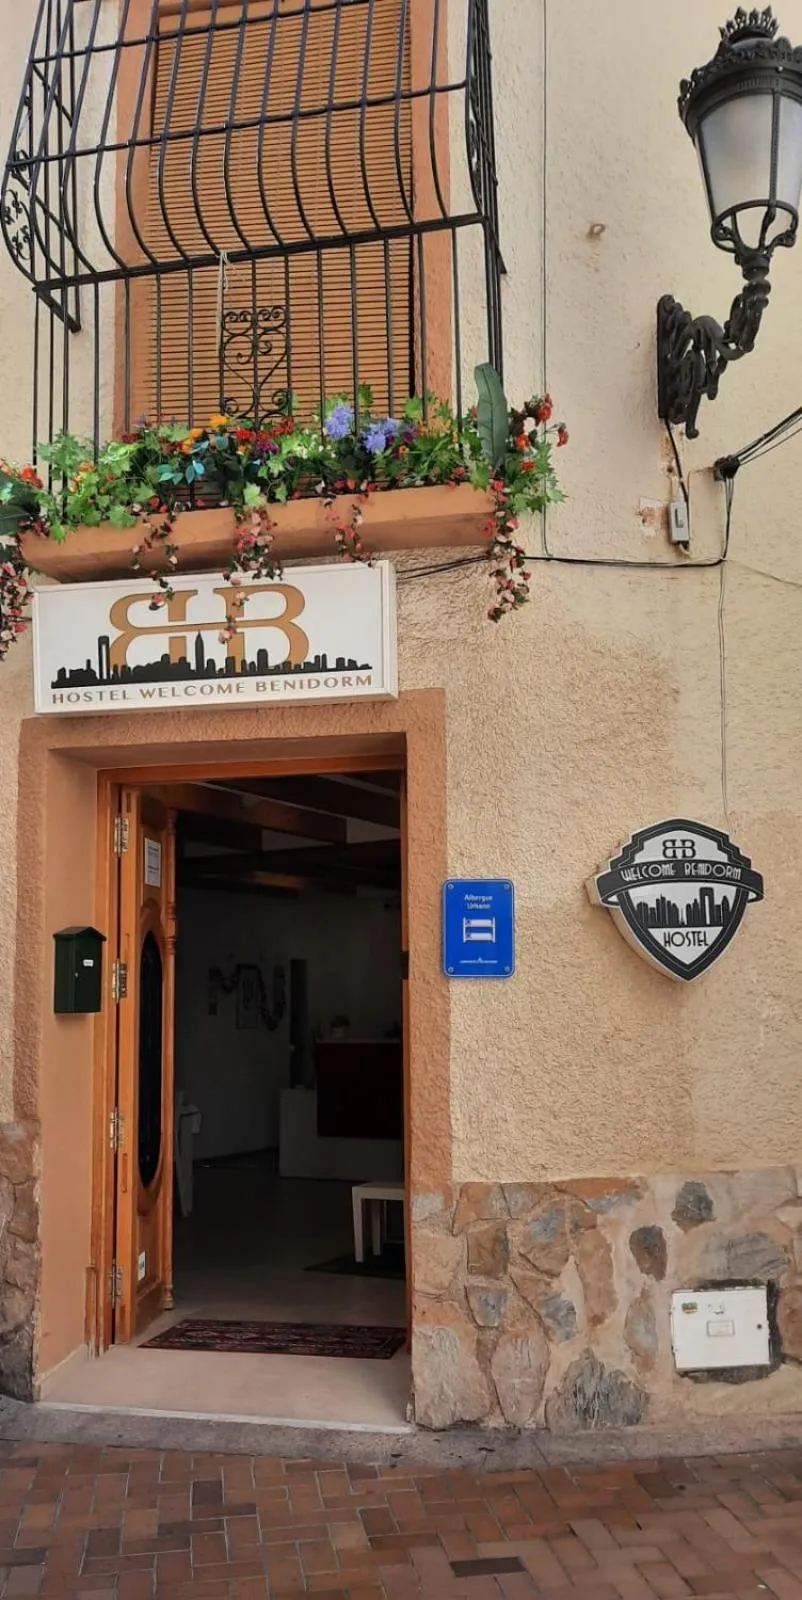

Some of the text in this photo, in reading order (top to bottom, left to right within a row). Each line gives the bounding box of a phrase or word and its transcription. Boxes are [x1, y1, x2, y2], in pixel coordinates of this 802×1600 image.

[52, 674, 373, 704] HOSTEL WELCOME BENIDORM
[620, 863, 742, 881] WELCOME BENIDORM
[464, 894, 493, 902] Albergue
[663, 931, 709, 948] HOSTEL
